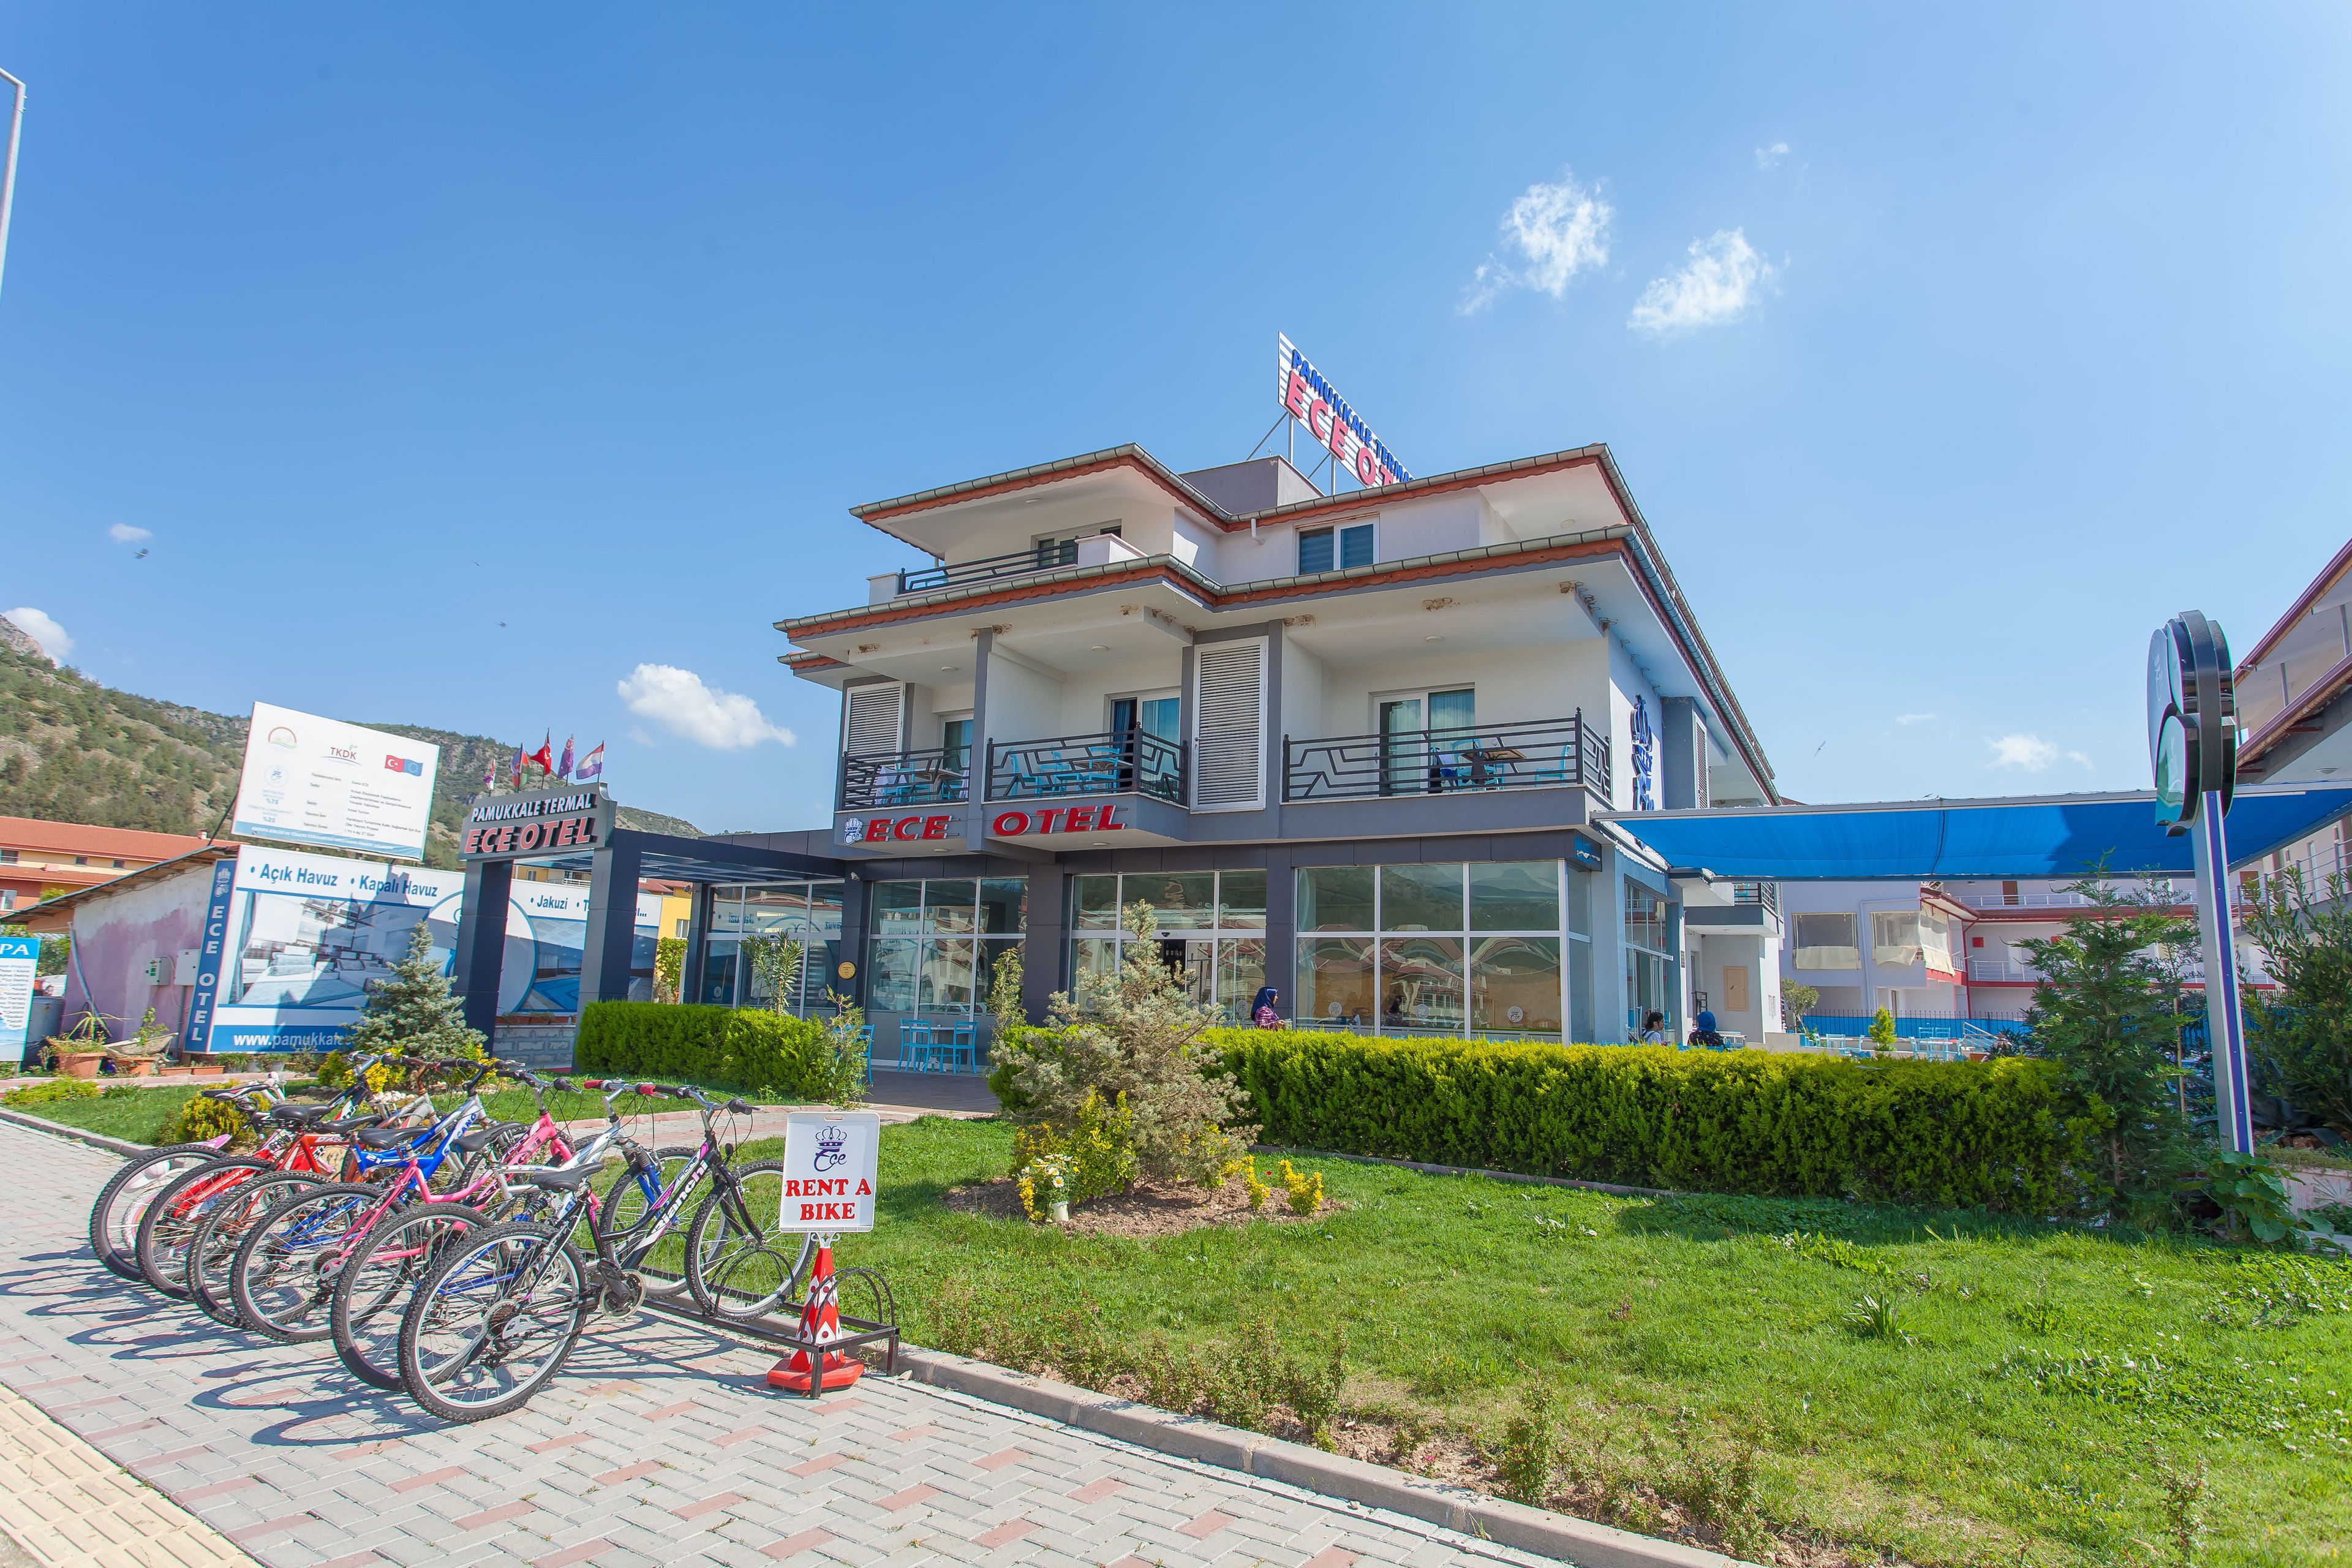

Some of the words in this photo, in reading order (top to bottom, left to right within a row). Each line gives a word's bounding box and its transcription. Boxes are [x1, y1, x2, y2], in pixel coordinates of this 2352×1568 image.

[1291, 349, 1374, 448] PAMUKKALE
[1284, 369, 1348, 460] ECE
[330, 747, 358, 760] TKDK
[471, 801, 541, 822] PAMUKKALE
[543, 793, 592, 814] TERMAL
[464, 826, 516, 854] ECE
[520, 816, 592, 850] OTEL
[864, 815, 952, 842] ECE
[992, 804, 1127, 836] OTEL
[260, 864, 291, 884] Açık
[297, 868, 338, 886] Havuz
[360, 875, 399, 896] Kapalı
[402, 880, 438, 897] Havuz
[537, 895, 568, 910] Jakuzi
[206, 905, 225, 954] ECE
[191, 973, 215, 1041] OTEL
[813, 1148, 848, 1172] Ece
[650, 1159, 709, 1234] Bianchi
[785, 1178, 849, 1197] RENT
[855, 1178, 872, 1196] A
[799, 1202, 856, 1221] BIKE
